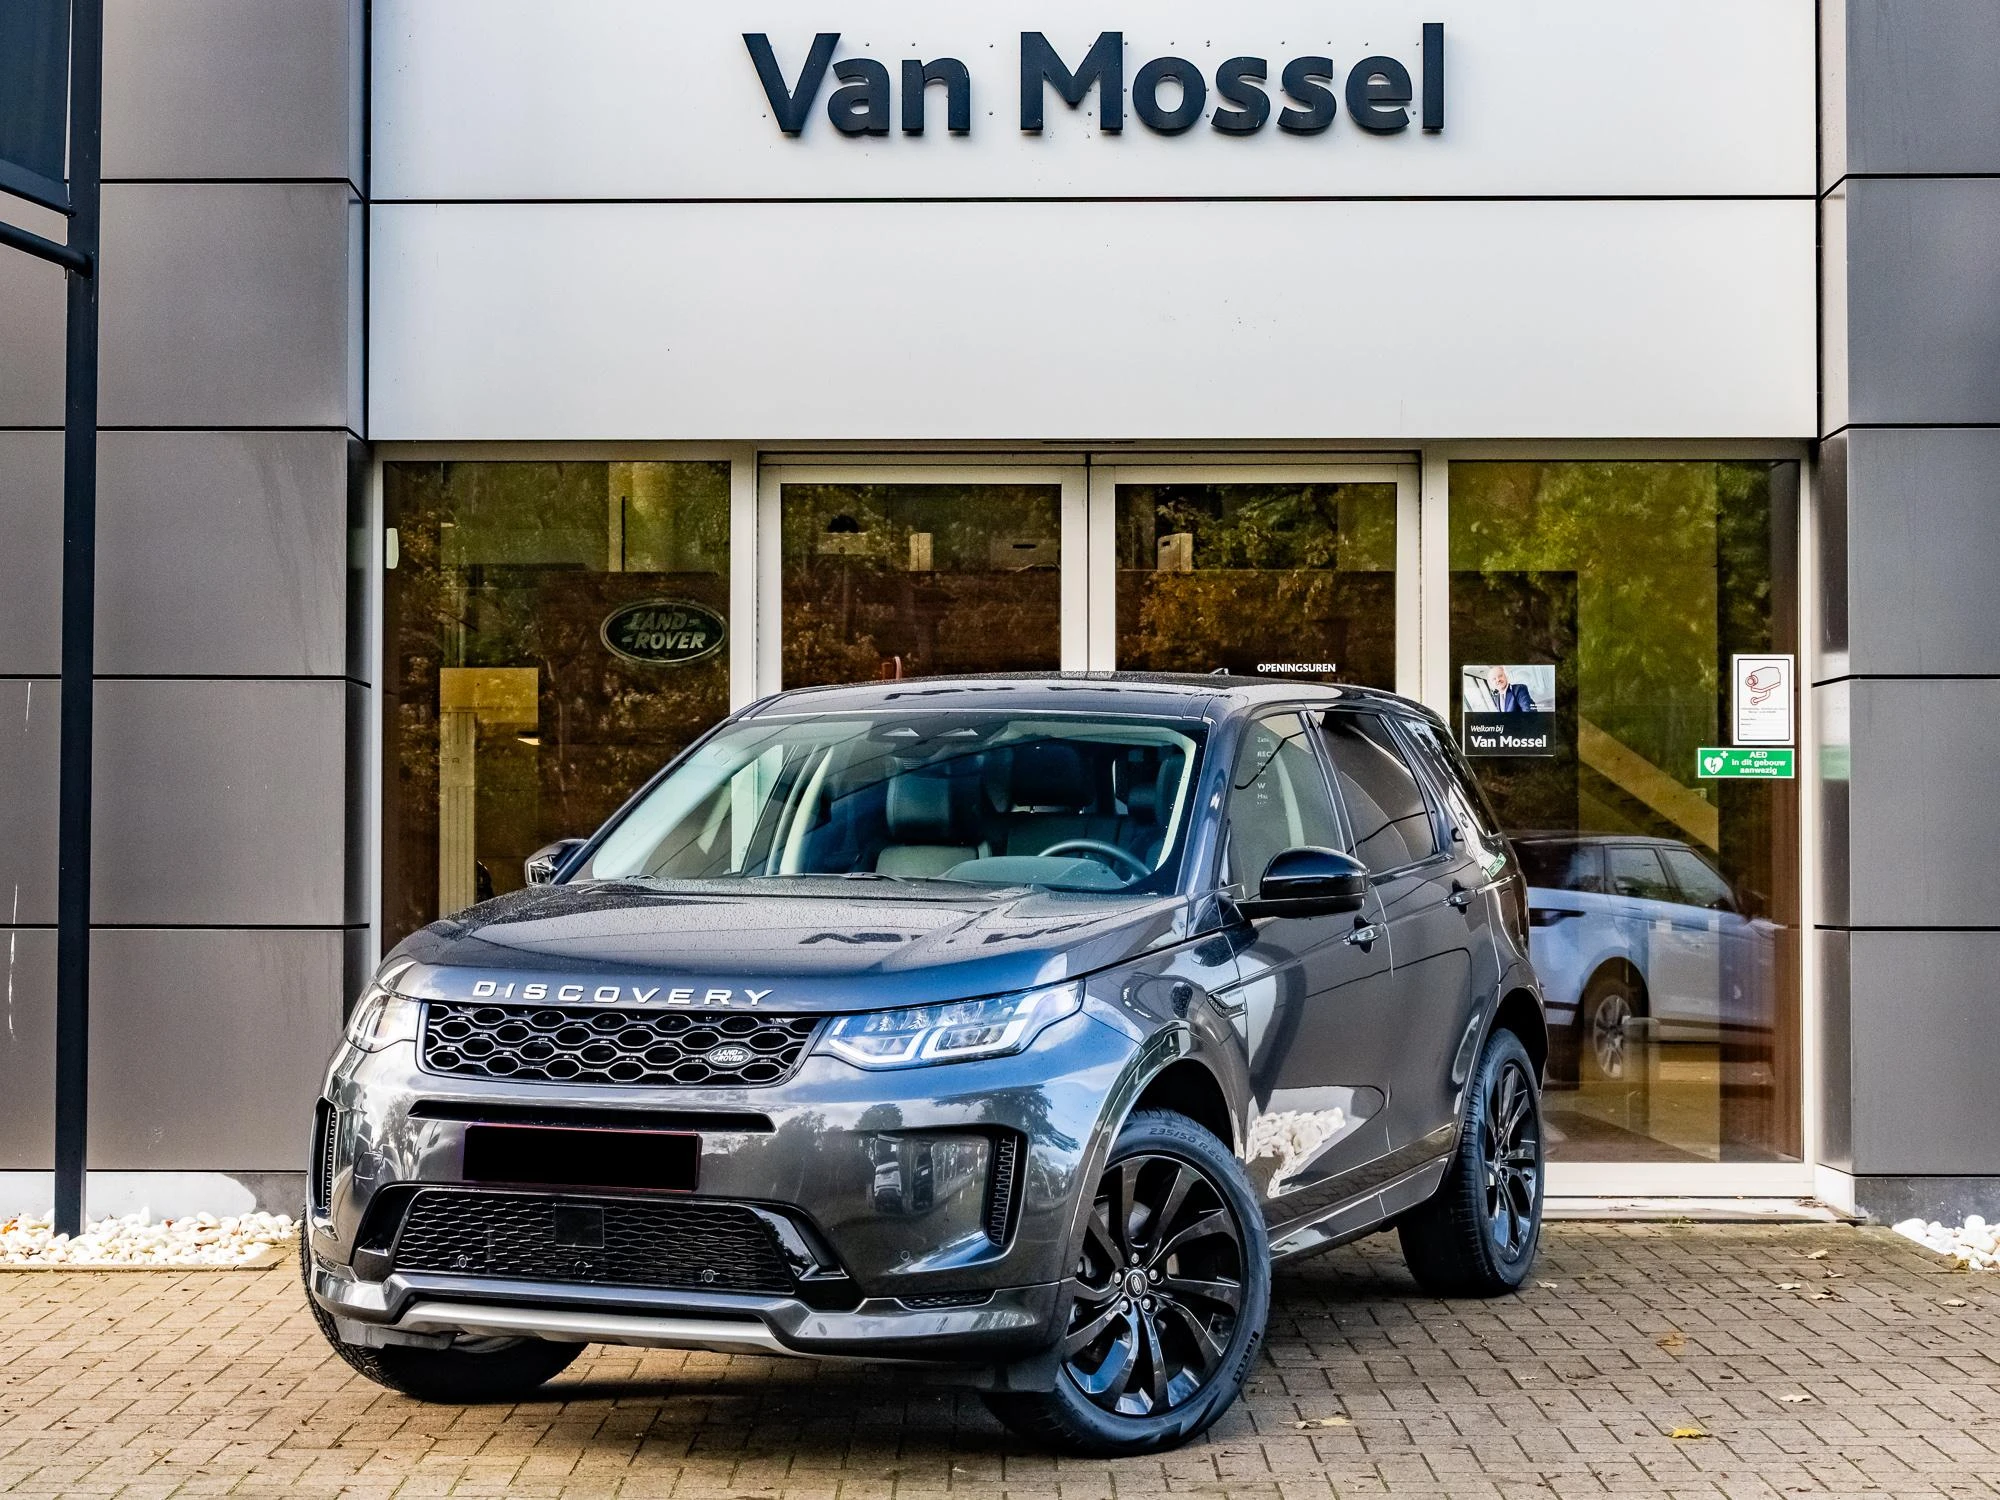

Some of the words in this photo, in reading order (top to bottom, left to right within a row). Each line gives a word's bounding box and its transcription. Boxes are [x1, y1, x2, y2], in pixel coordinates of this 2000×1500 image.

[742, 32, 971, 136] Van
[1020, 22, 1445, 136] Mossel
[623, 611, 688, 631] LAND
[634, 631, 707, 650] ROVER
[1256, 663, 1337, 673] OPENINGSUREN
[1470, 725, 1495, 733] Welkom
[1495, 725, 1505, 734] bij
[1470, 735, 1497, 748] Van
[1499, 734, 1547, 748] Mossel
[1749, 751, 1768, 759] AED
[1753, 759, 1787, 768] gebouw
[1739, 767, 1778, 776] aanwezig
[472, 981, 775, 1006] DISCOVERY
